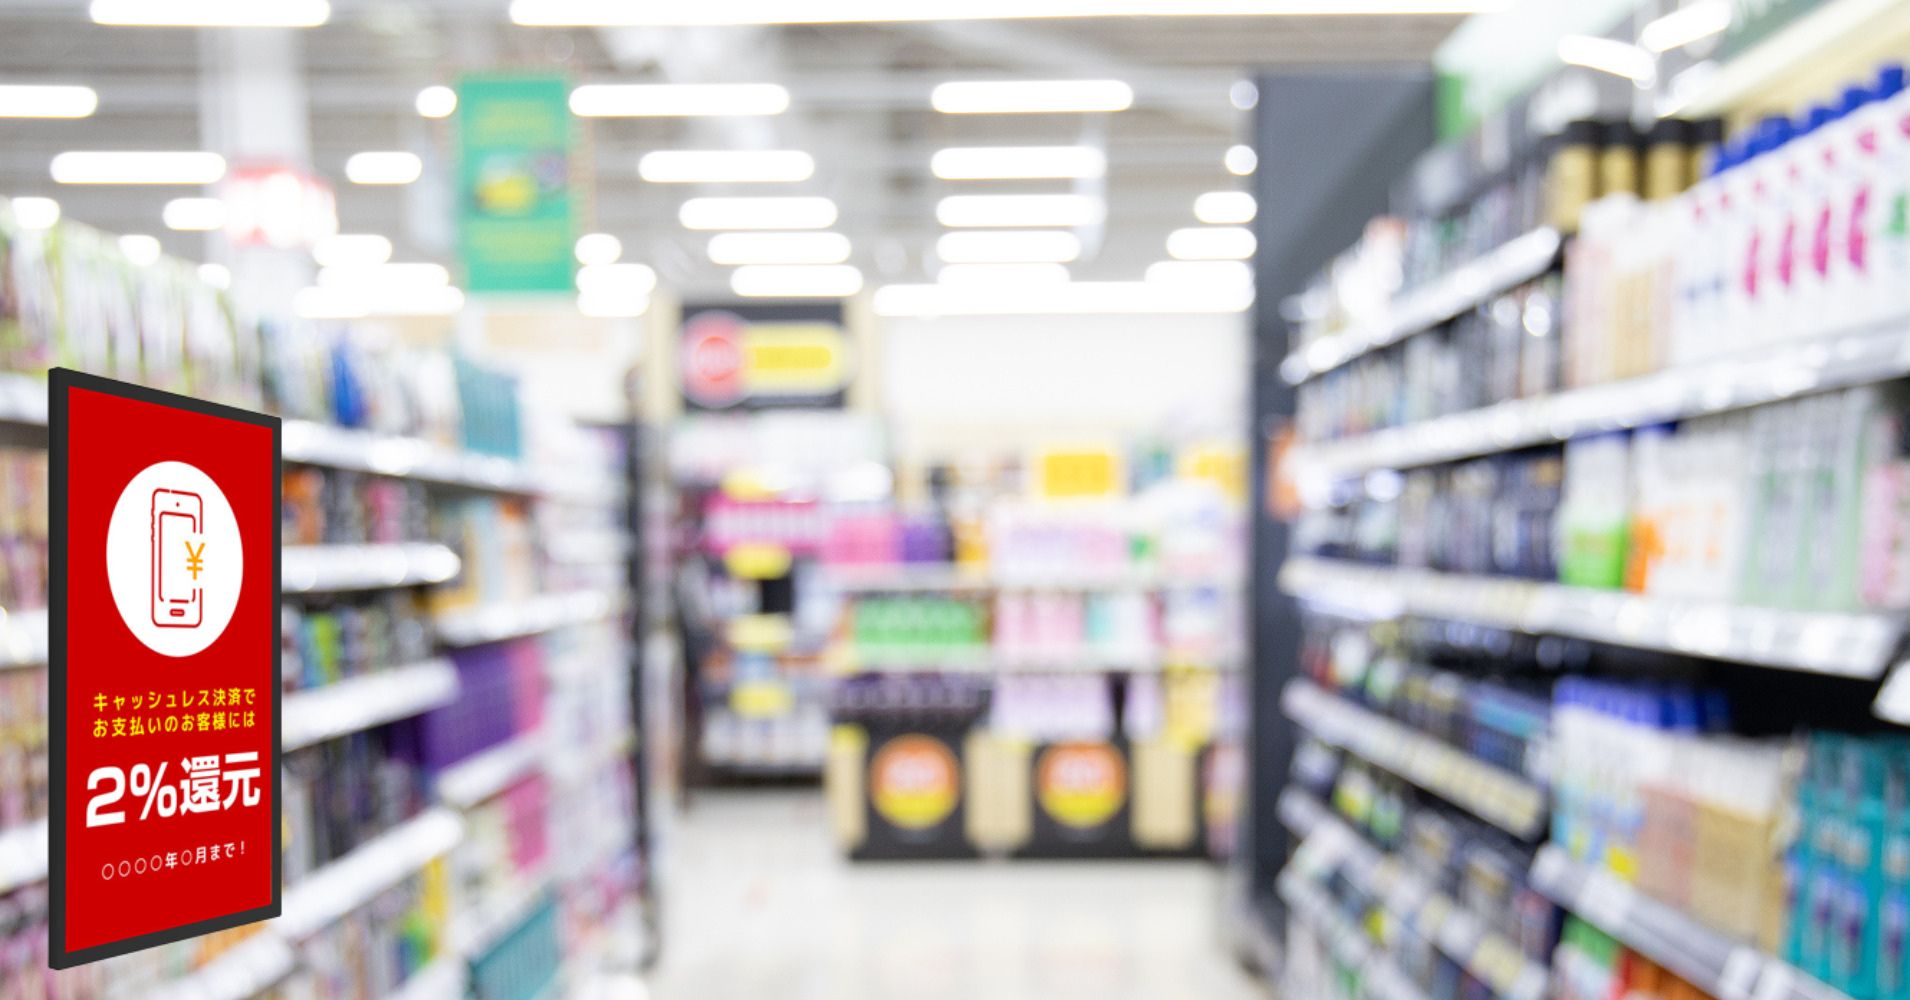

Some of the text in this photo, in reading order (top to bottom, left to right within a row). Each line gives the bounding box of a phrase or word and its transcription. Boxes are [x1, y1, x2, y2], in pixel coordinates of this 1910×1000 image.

[93, 688, 256, 712] キャッシュレス決済で
[93, 711, 256, 738] お支払いのお客様には
[86, 751, 261, 828] 2%還元
